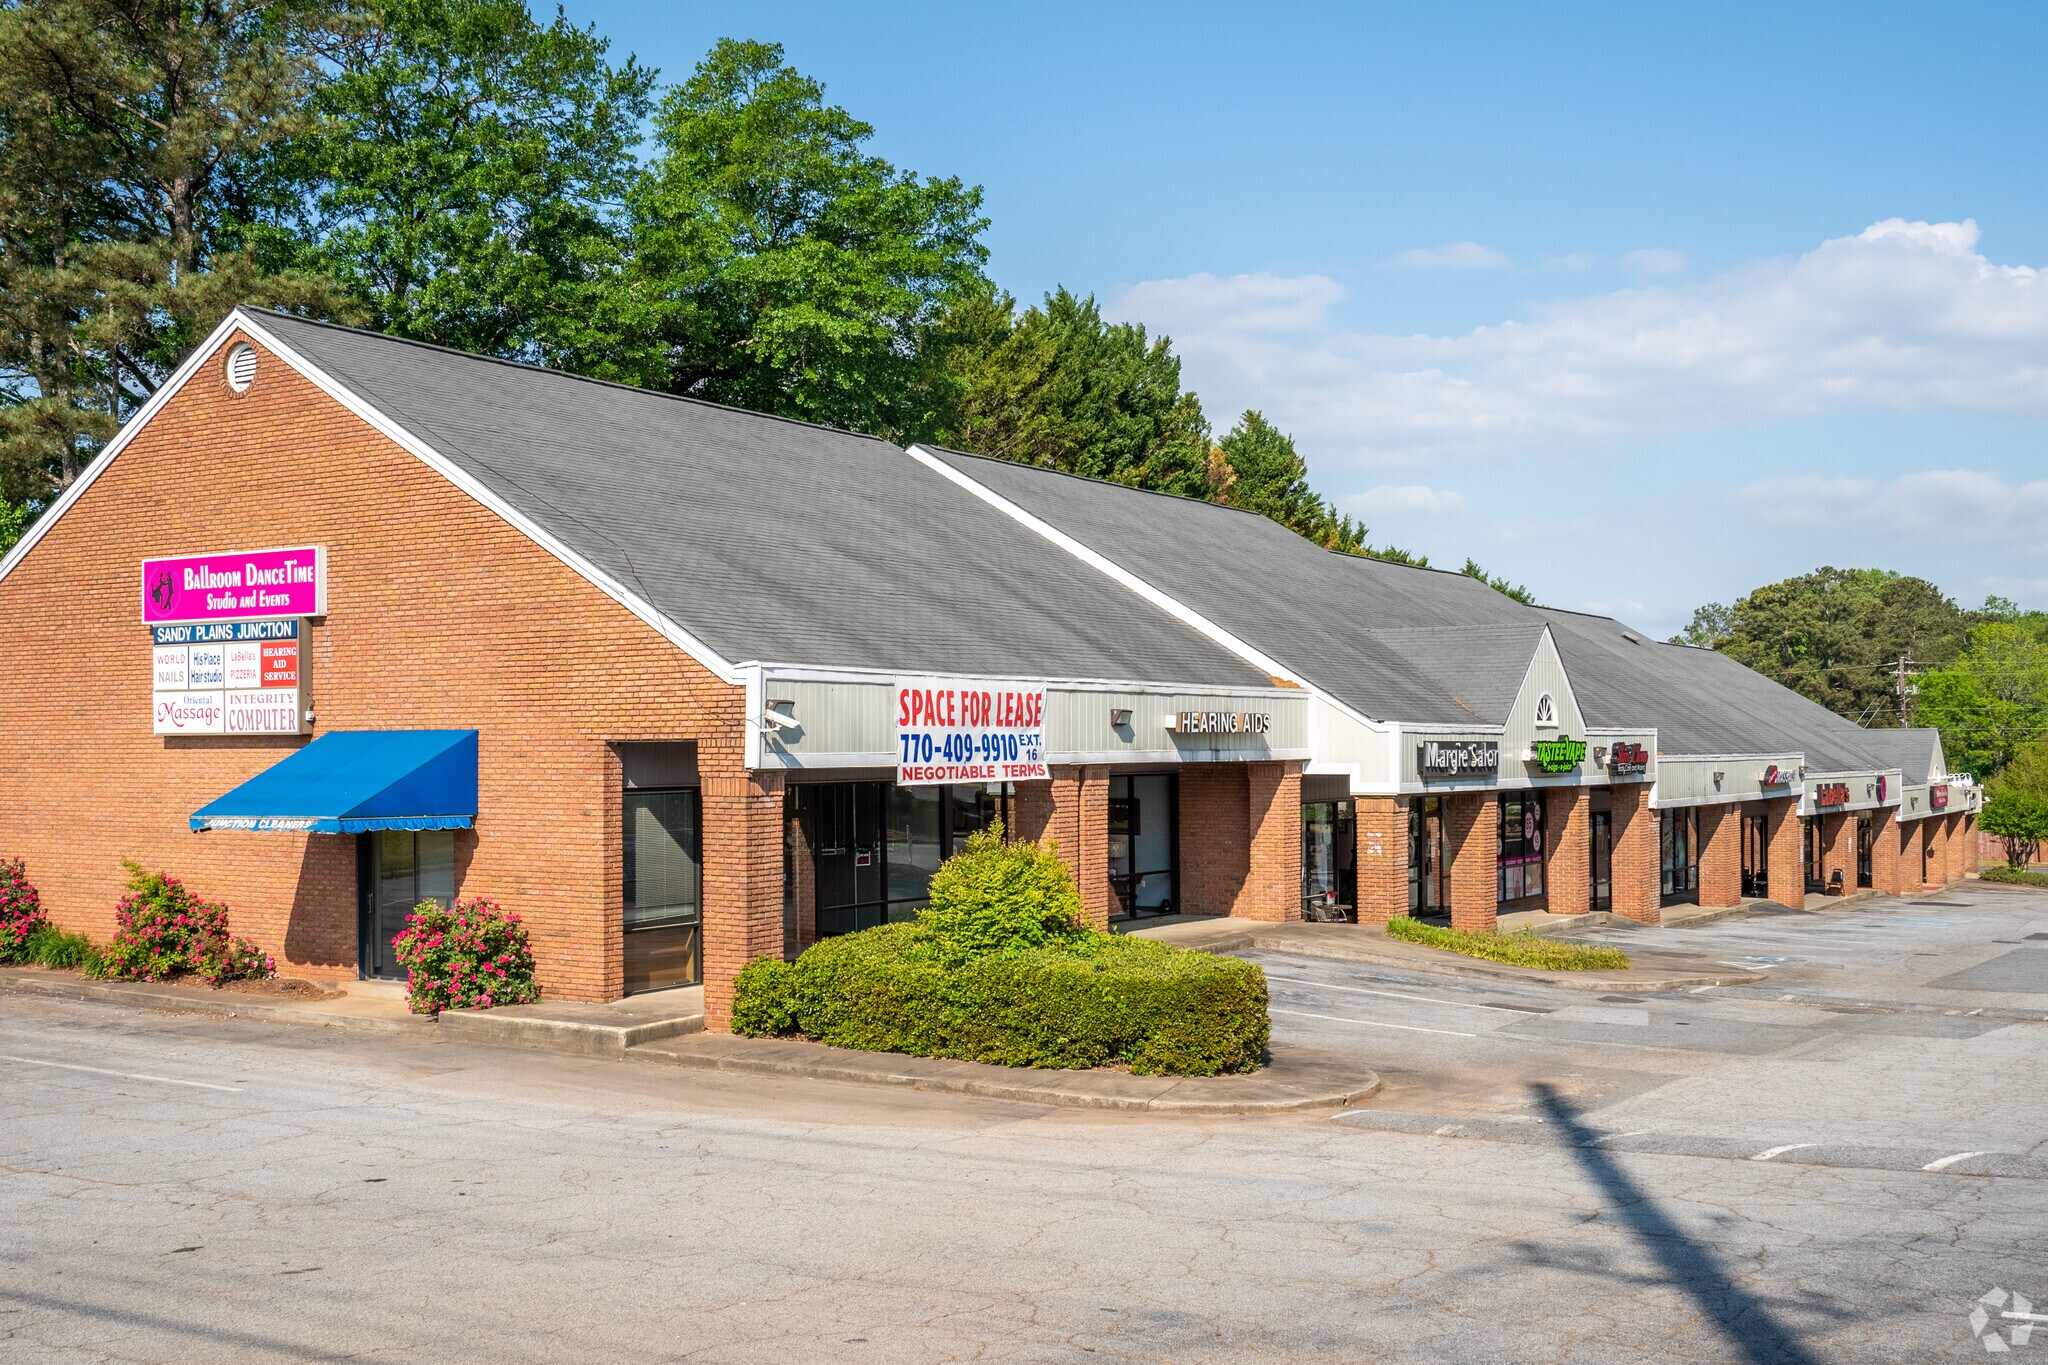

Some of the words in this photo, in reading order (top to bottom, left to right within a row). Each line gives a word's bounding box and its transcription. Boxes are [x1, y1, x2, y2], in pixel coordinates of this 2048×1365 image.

[157, 626, 192, 643] SANDY
[196, 624, 233, 641] PLAINS
[237, 621, 292, 638] JUNCTION
[263, 646, 297, 657] HEARING
[157, 653, 186, 665] WORLD
[273, 660, 287, 669] AID
[158, 671, 185, 683] NAILS
[230, 669, 257, 680] PIZZERIA
[264, 671, 296, 681] SERVICE
[183, 695, 213, 704] Oriental
[230, 693, 295, 705] INTEGRITY
[899, 688, 956, 727] SPACE
[961, 690, 992, 727] FOR
[996, 691, 1043, 727] LEASE
[157, 701, 221, 728] Massage
[229, 708, 296, 732] COMPUTER
[1181, 711, 1238, 734] HEARING
[1243, 712, 1271, 734] AIDS
[900, 733, 1018, 763] 770-409-9910
[1019, 734, 1042, 746] EXT.
[1026, 748, 1038, 761] 16
[1425, 741, 1468, 775] Margie
[1468, 742, 1499, 767] Salon
[902, 765, 996, 781] NEGOTIABLE
[1002, 763, 1046, 778] TERMS
[204, 818, 257, 829] JUNCTION
[258, 819, 312, 829] CLEANERS
